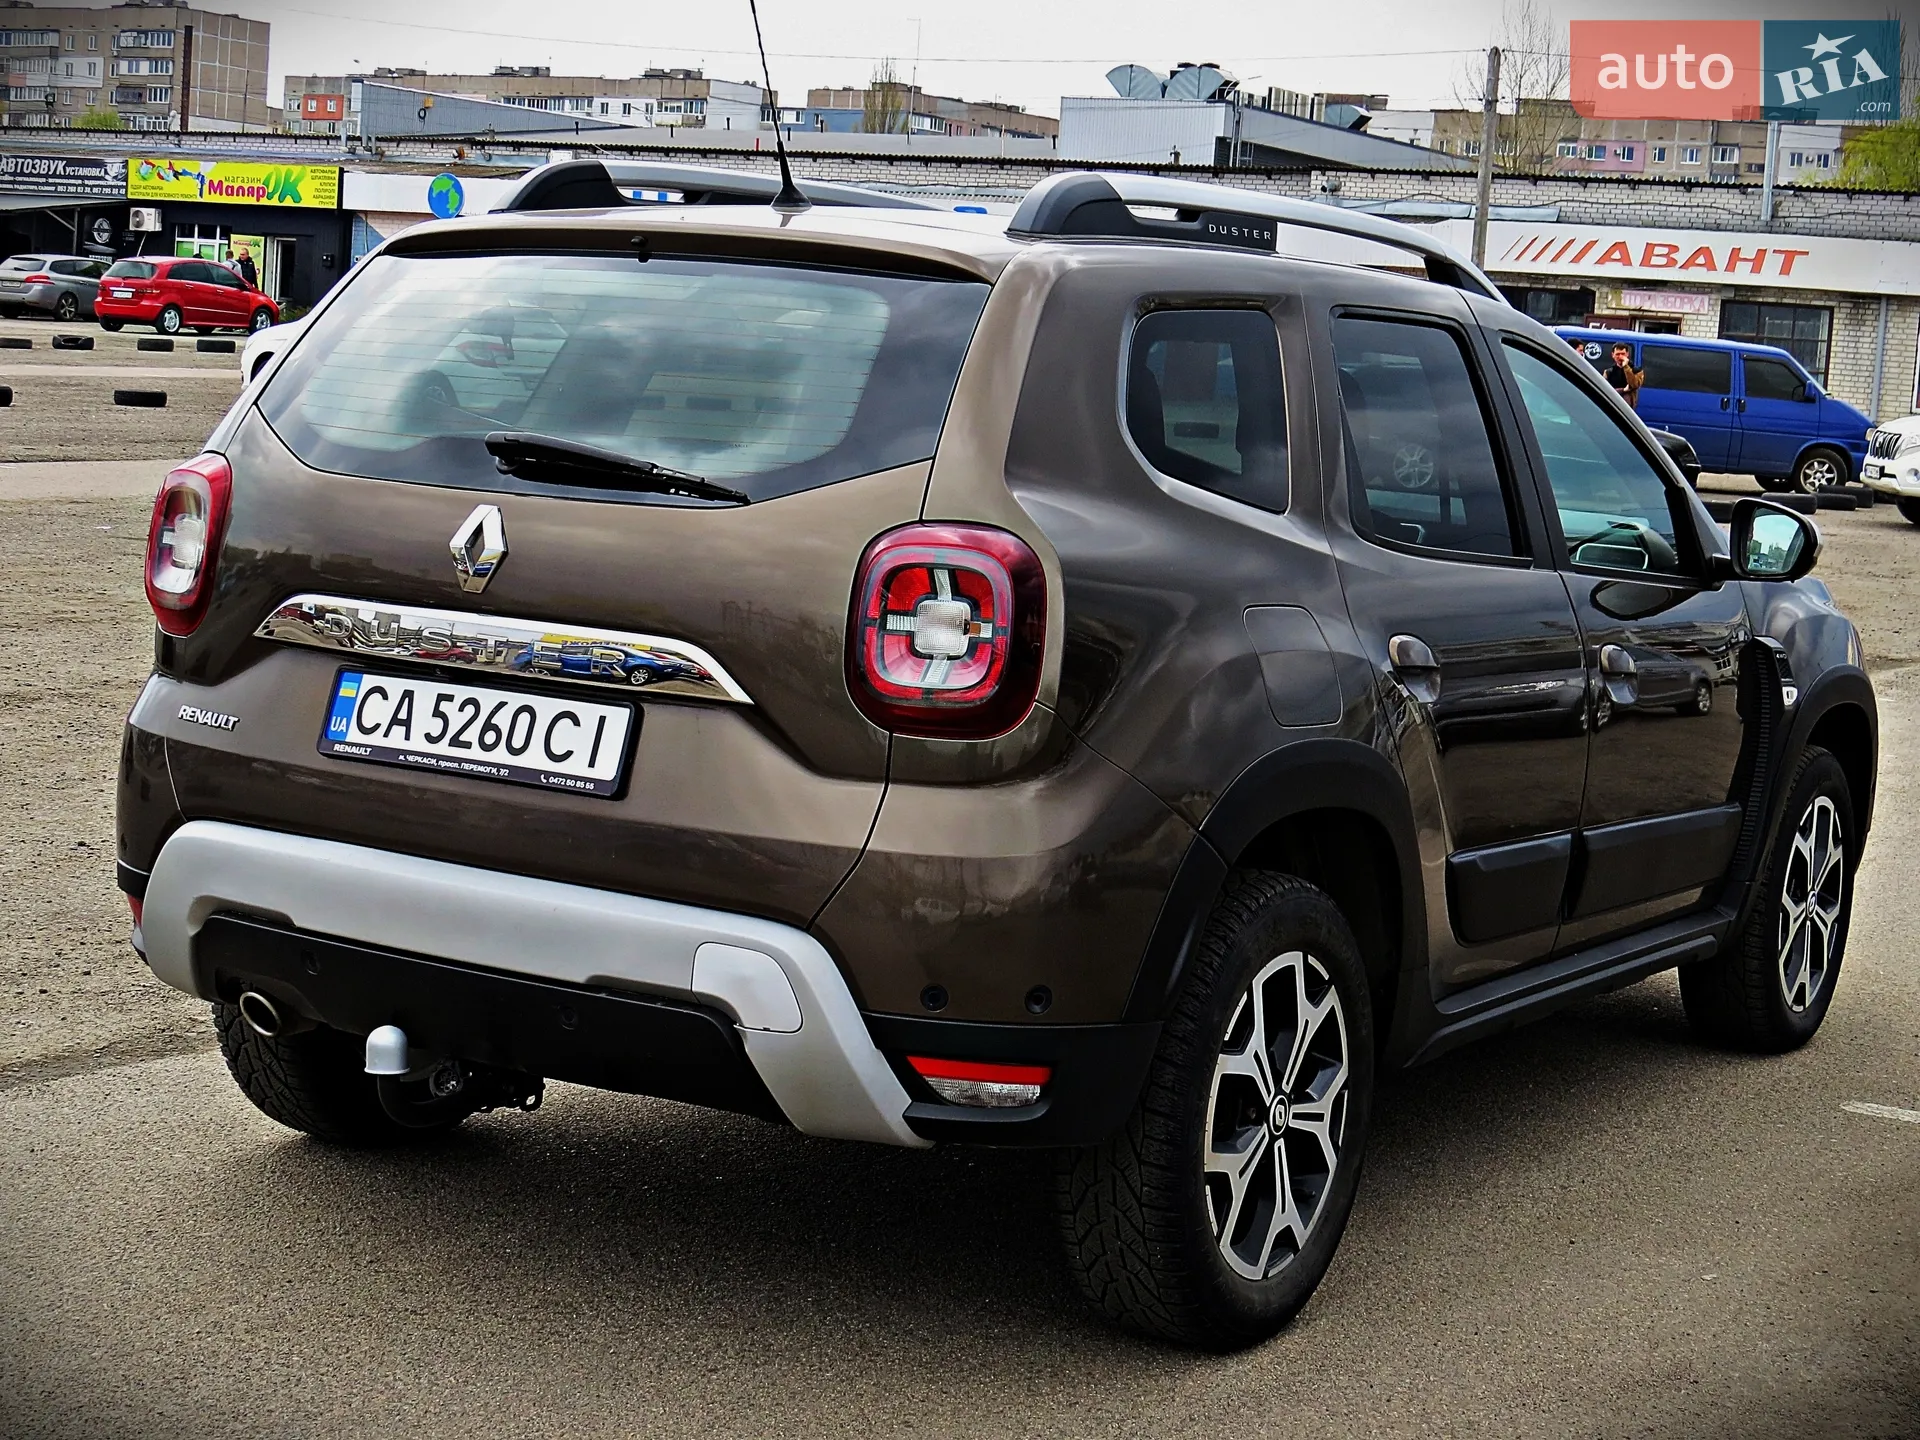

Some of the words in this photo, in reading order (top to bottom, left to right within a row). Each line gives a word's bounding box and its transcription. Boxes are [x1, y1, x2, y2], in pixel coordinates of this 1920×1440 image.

[0, 157, 67, 176] АВТОЗВУК
[65, 166, 105, 177] УСТАНОВКА
[224, 175, 262, 184] магазин
[1208, 224, 1271, 240] DUSTER
[1594, 240, 1810, 277] АВАНТ
[323, 612, 627, 678] DUSTER
[178, 704, 240, 731] RENAULT
[330, 715, 347, 733] UA
[356, 685, 415, 741] CA
[424, 692, 537, 757] 5260
[544, 710, 607, 769] CI
[333, 743, 372, 756] RENAULT
[406, 754, 438, 767] ЧЕРКАСИ,
[460, 762, 499, 775] ПЕРЕМОГИ,
[548, 776, 566, 787] 0472
